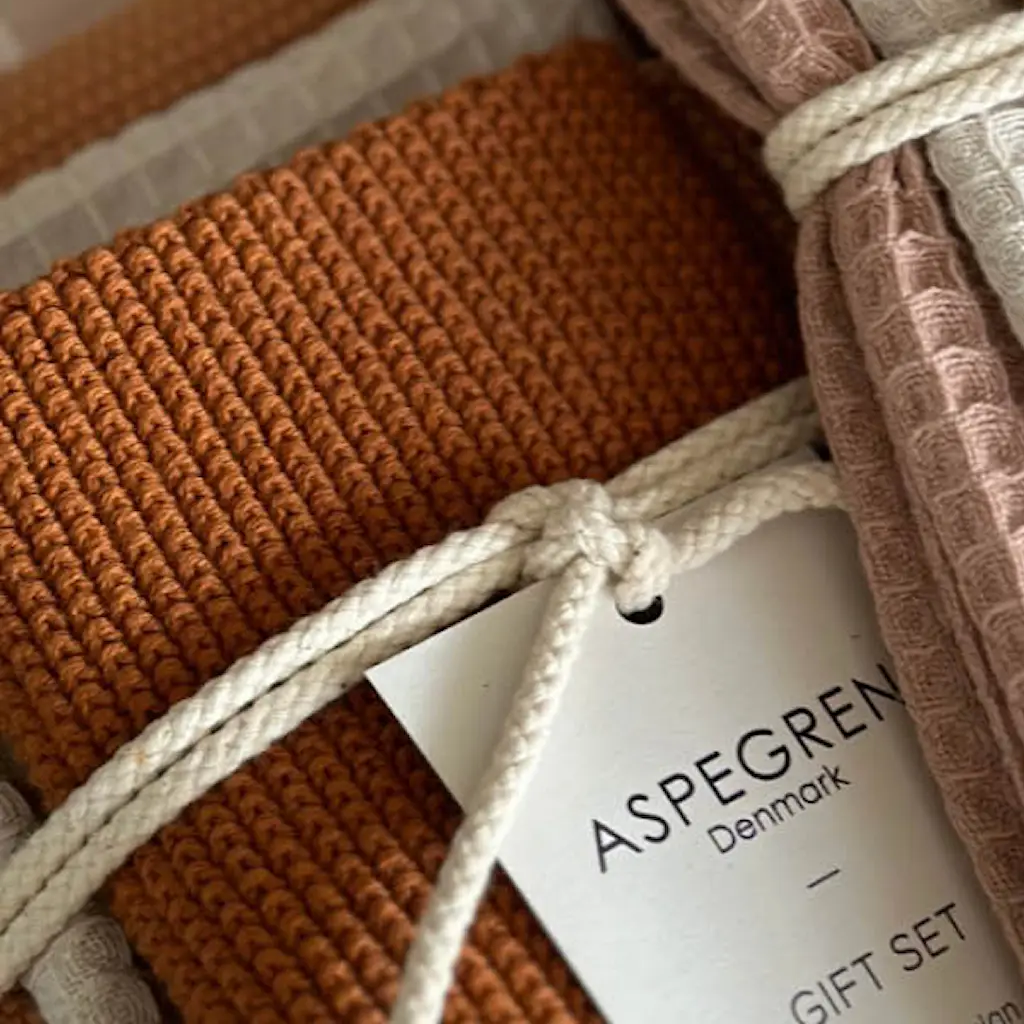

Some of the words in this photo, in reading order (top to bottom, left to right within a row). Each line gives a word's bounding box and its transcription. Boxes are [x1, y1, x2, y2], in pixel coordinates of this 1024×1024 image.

[590, 662, 906, 874] ASPEGREN
[707, 763, 851, 855] Denmark
[789, 951, 884, 1024] GIFT
[888, 902, 967, 973] SET
